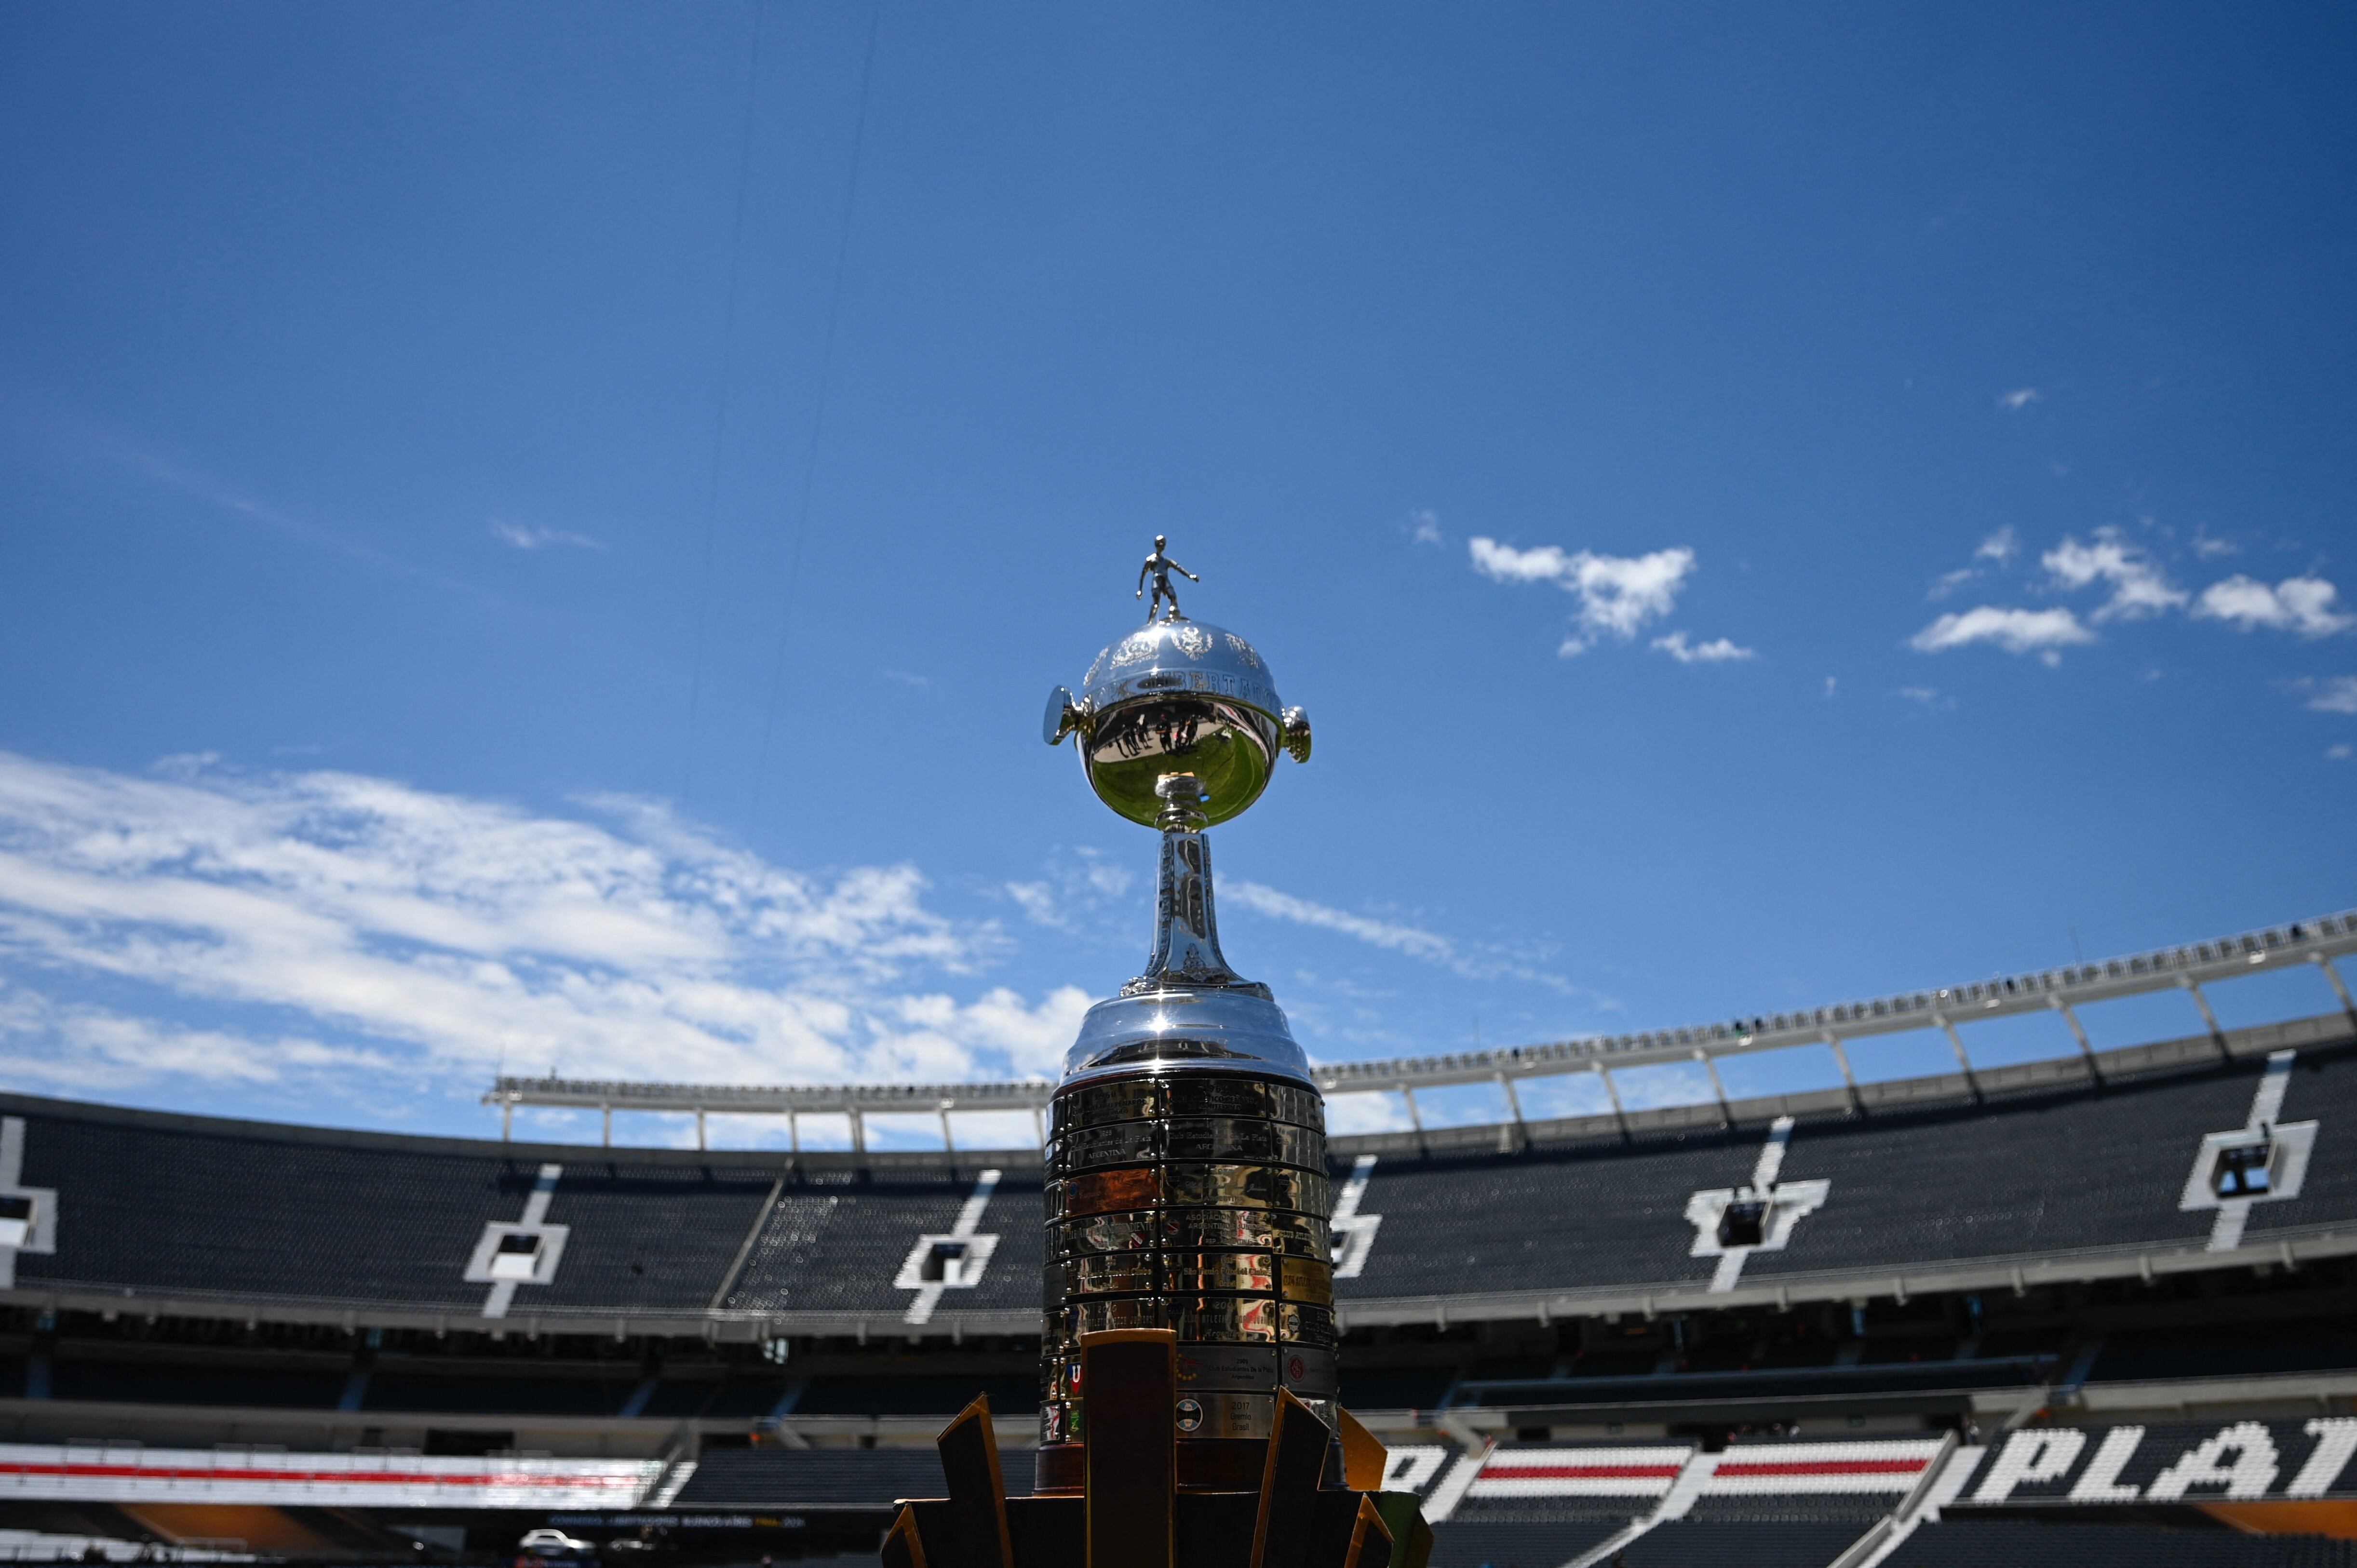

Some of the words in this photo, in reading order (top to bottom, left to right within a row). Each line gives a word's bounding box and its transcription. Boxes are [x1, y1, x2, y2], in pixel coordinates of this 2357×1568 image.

[1072, 1365, 1081, 1383] U
[1232, 1402, 1250, 1410] 2017
[1230, 1412, 1252, 1421] Gremio
[1232, 1422, 1250, 1431] Brasil
